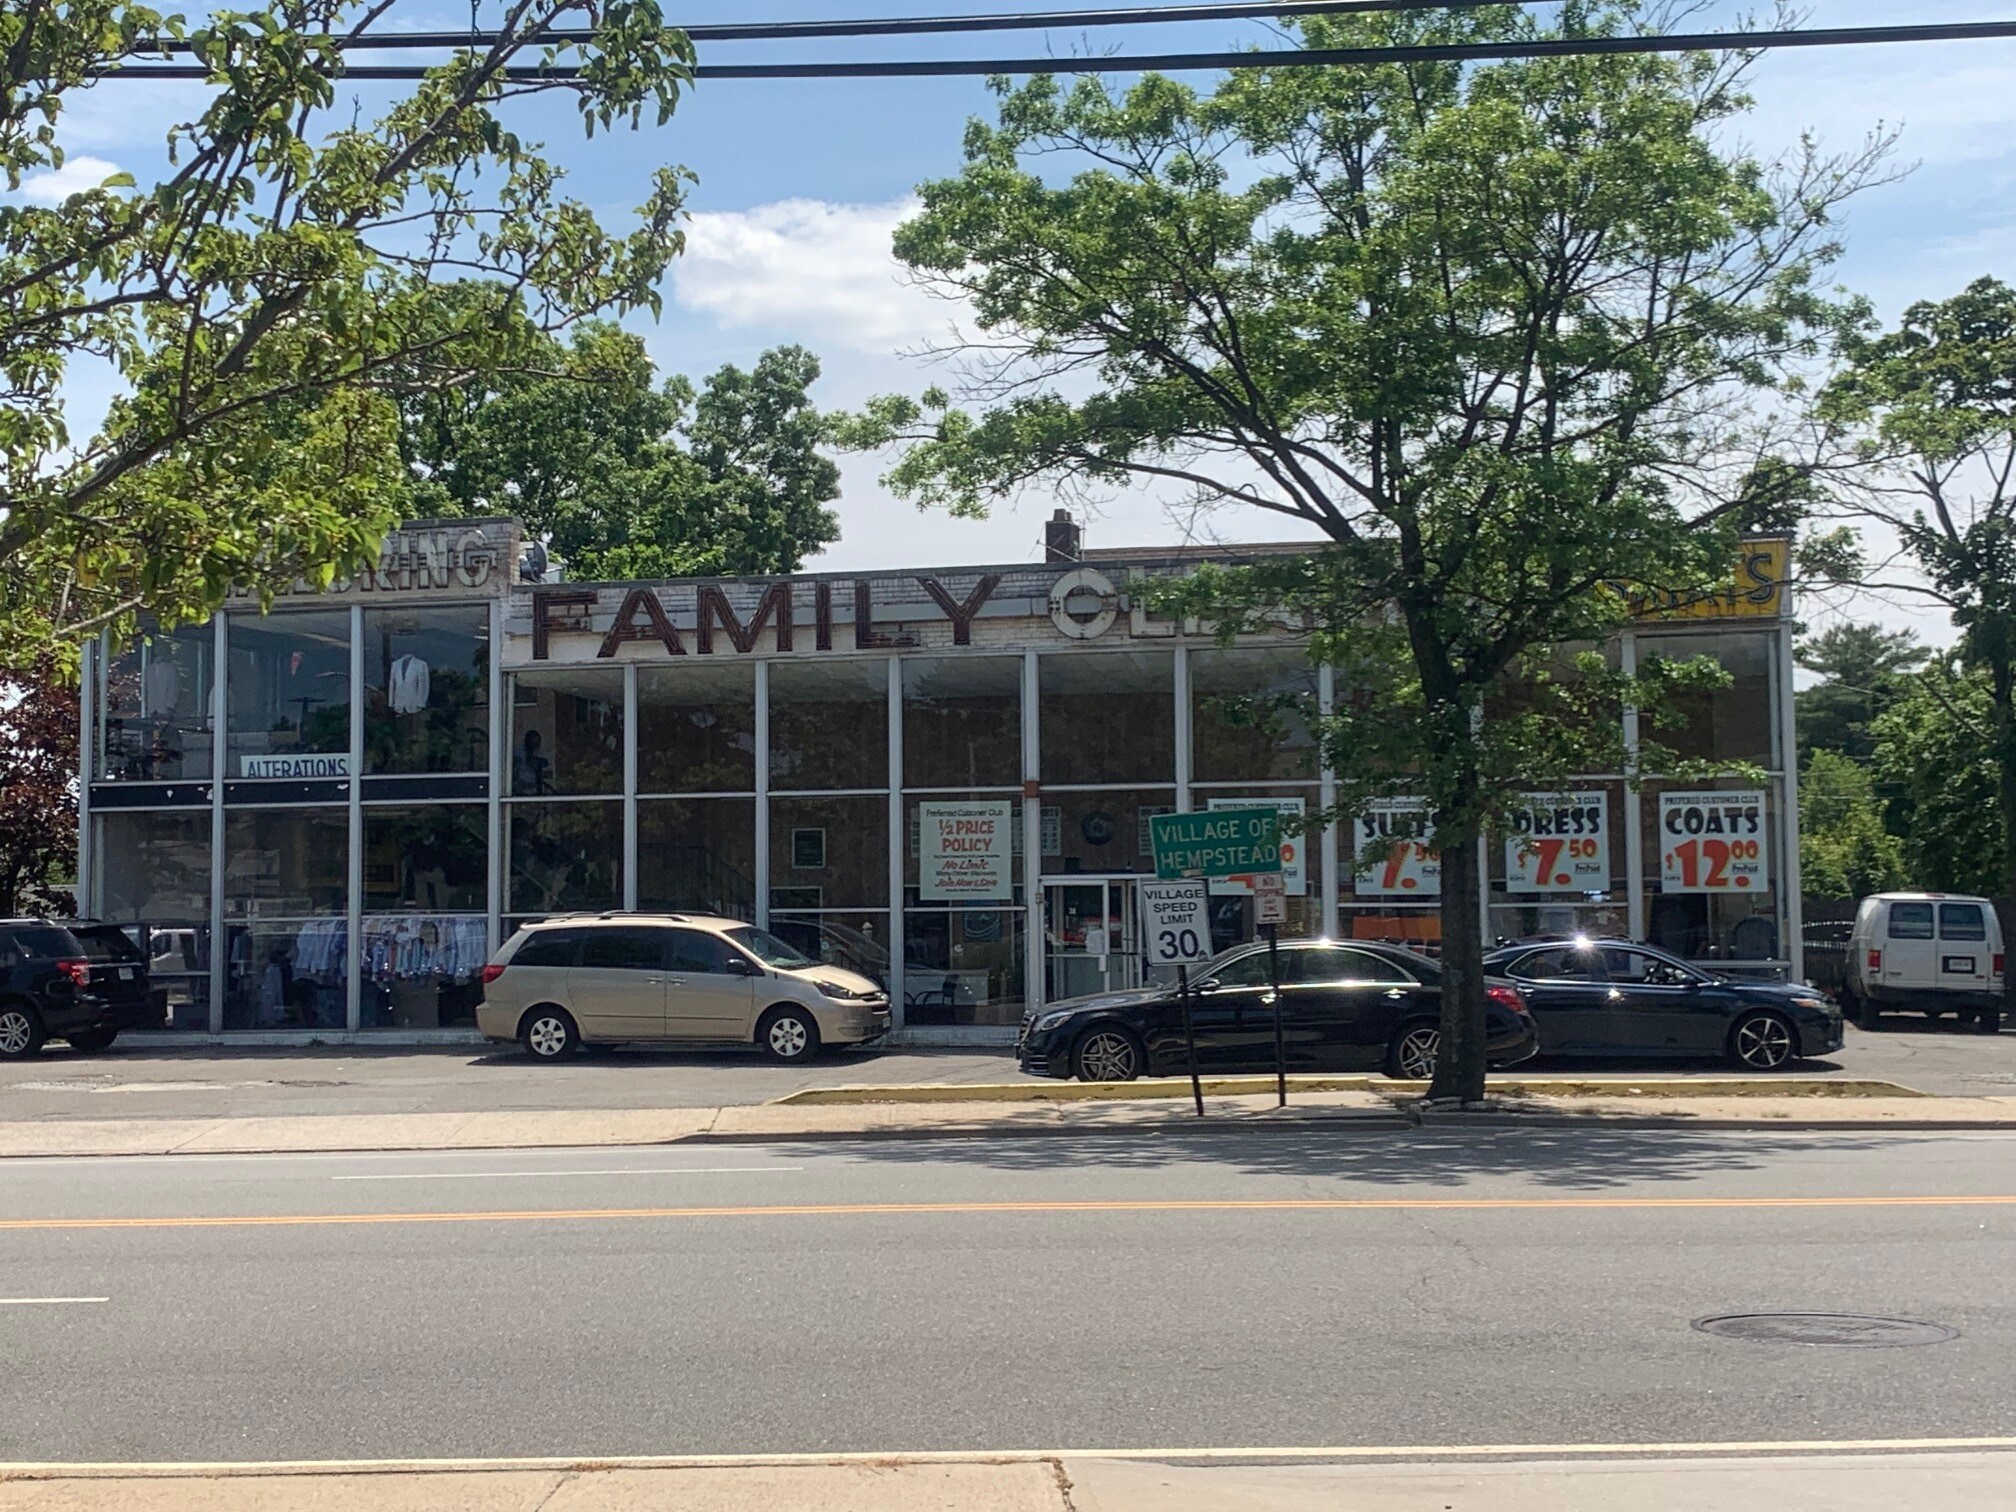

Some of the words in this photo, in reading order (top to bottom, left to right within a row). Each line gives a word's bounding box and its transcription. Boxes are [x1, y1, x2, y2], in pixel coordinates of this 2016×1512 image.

[532, 573, 1001, 660] FAMILY
[247, 758, 347, 778] ALTERATIONS
[955, 820, 995, 835] PRICE
[1512, 806, 1600, 835] DRESS
[1665, 806, 1759, 835] COATS
[1158, 820, 1241, 844] VILLAGE
[1249, 818, 1273, 839] OF
[941, 837, 993, 852] POLICY
[942, 860, 958, 871] No
[958, 858, 990, 870] Limit
[1160, 845, 1277, 870] HEMPSTEAD
[1145, 888, 1205, 900] VILLAGE
[1153, 902, 1198, 913] SPEED
[1160, 913, 1194, 925] LIMIT
[1159, 928, 1199, 960] 30
